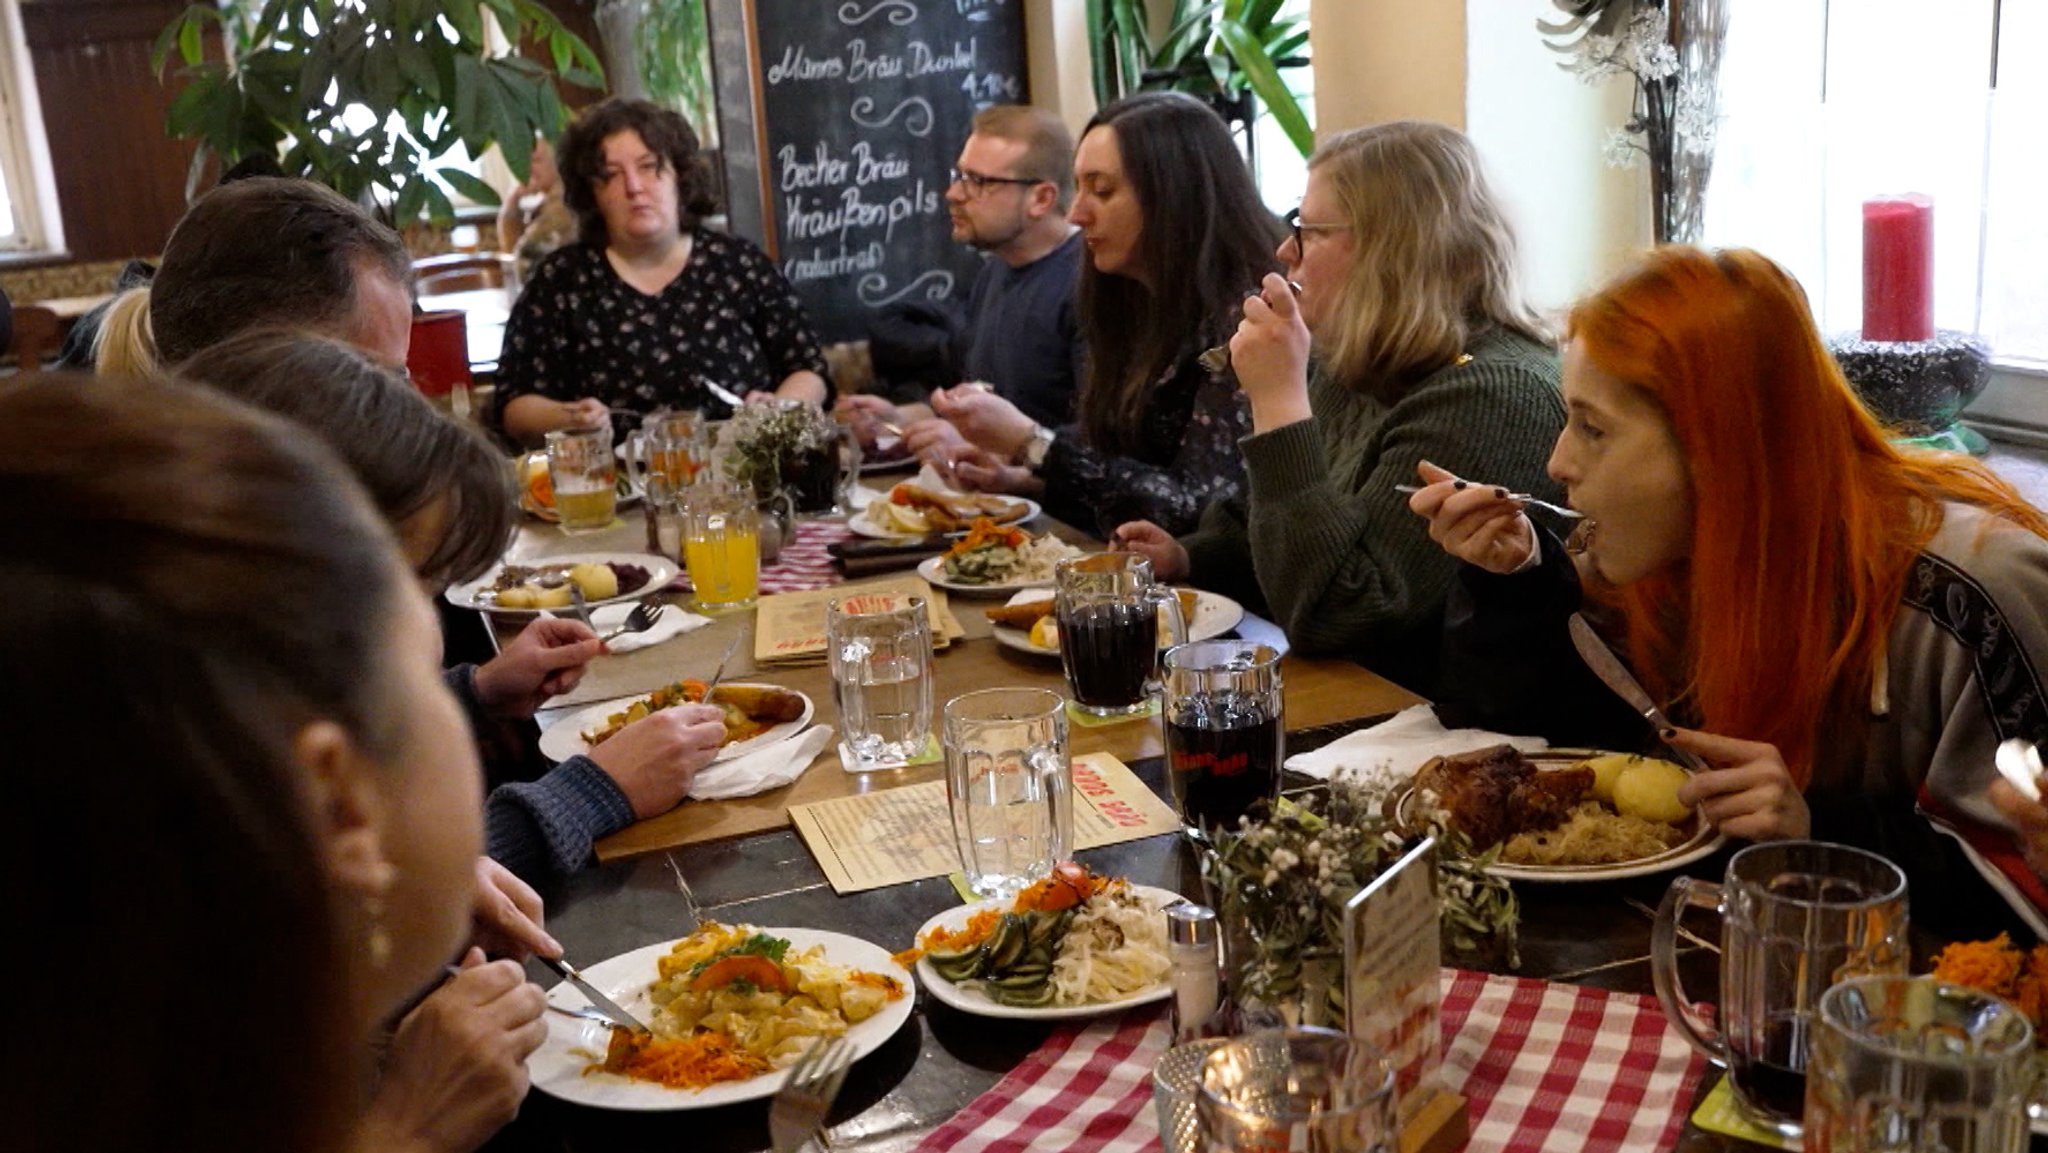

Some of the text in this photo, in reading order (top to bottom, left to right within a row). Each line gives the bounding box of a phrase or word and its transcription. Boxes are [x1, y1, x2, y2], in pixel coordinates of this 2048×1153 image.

[846, 38, 903, 83] Bräu
[778, 140, 910, 191] Becher Bräu
